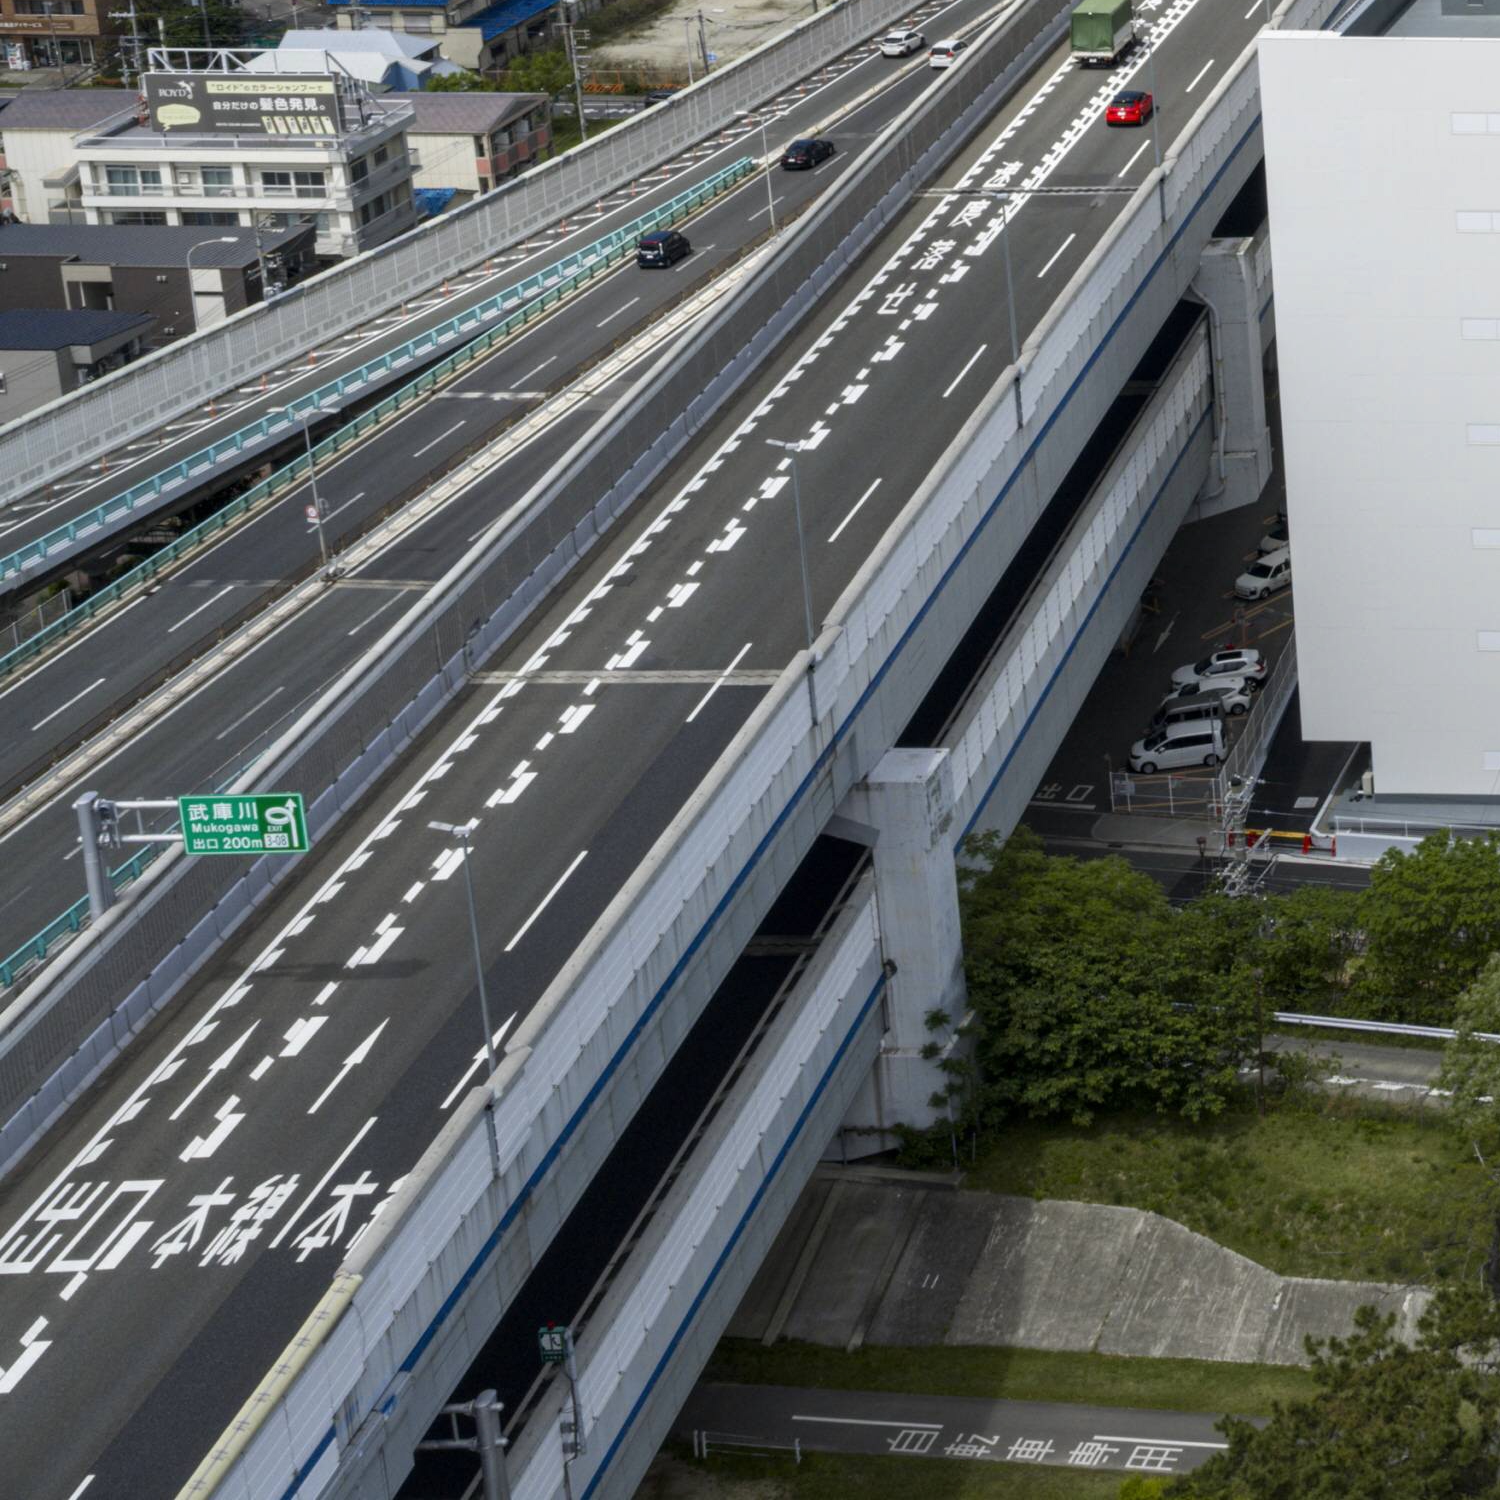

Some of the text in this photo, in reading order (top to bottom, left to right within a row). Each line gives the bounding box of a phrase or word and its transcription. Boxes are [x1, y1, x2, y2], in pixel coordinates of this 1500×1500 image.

[877, 161, 1024, 314] 速度落せ
[188, 802, 258, 821] 武庫川
[191, 823, 259, 834] Mukogawa
[193, 837, 262, 849] 出口 200m
[265, 835, 288, 847] 3-08
[150, 1174, 300, 1269] 本線
[887, 1429, 1184, 1470] 自転車専用
